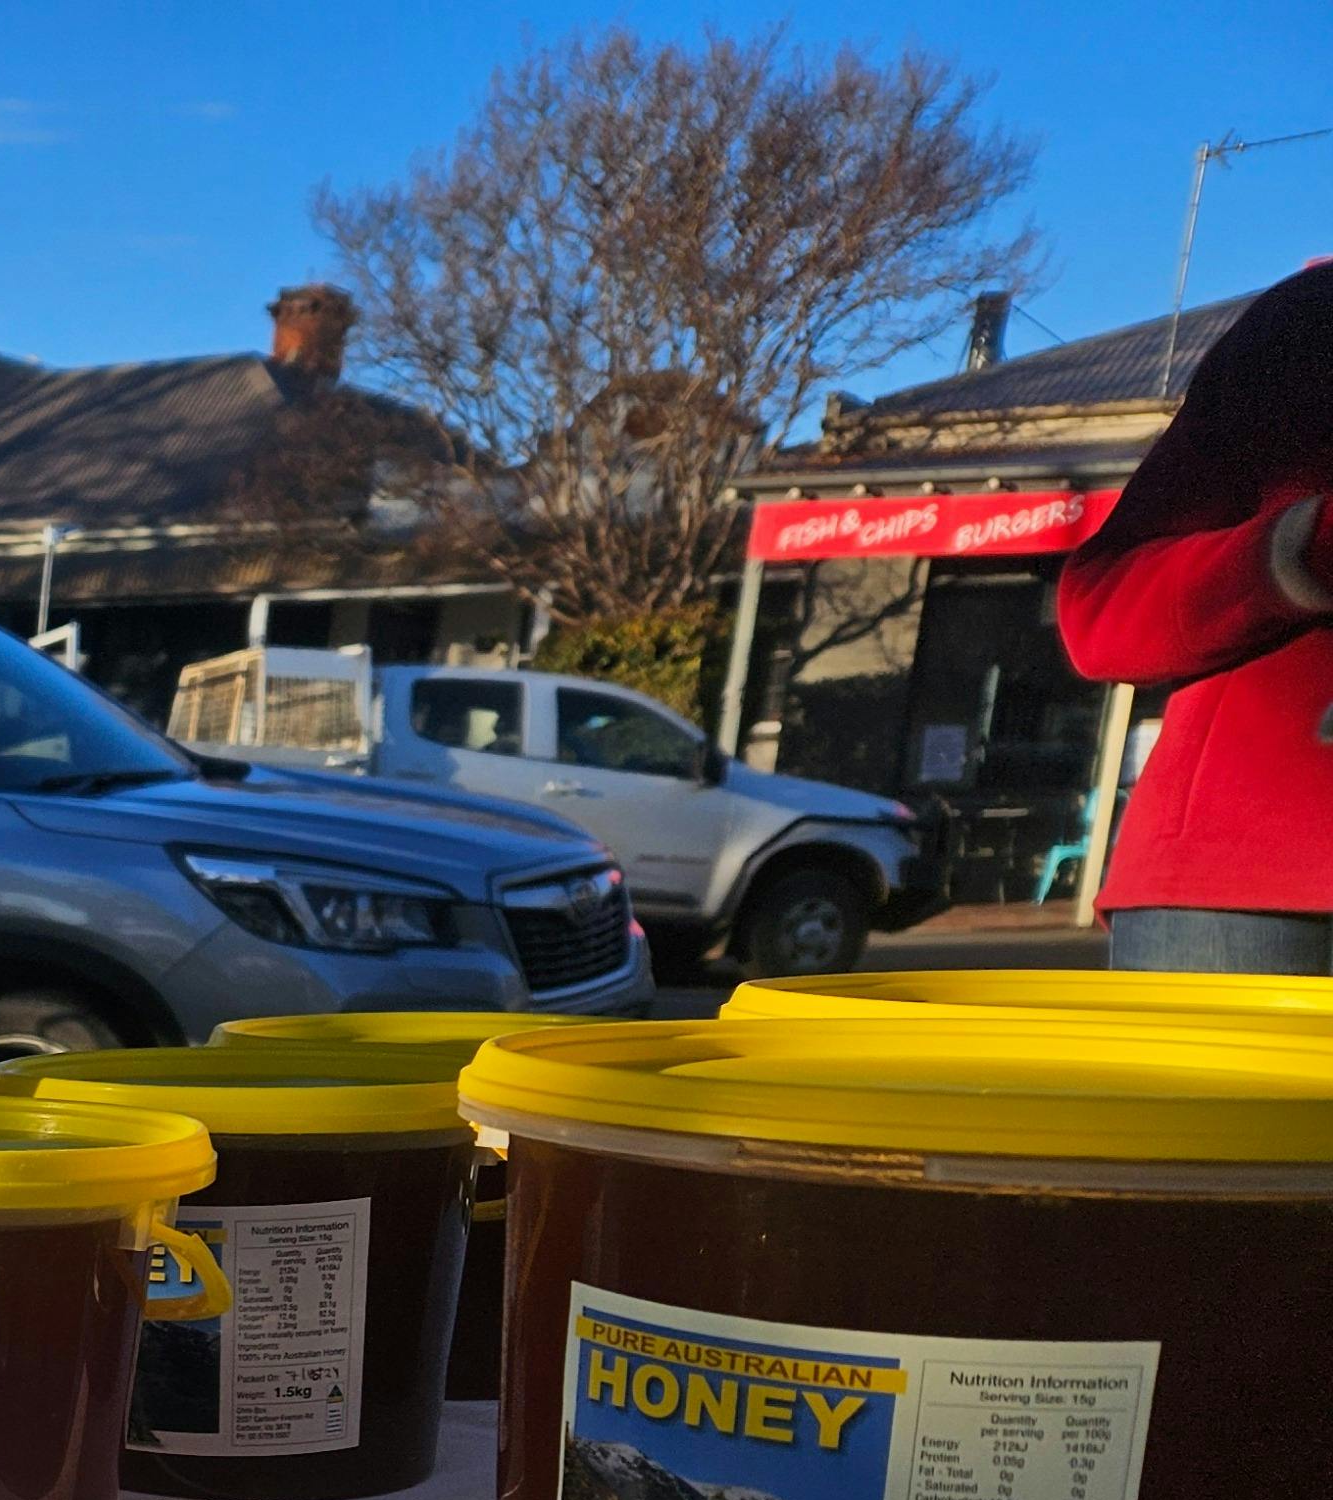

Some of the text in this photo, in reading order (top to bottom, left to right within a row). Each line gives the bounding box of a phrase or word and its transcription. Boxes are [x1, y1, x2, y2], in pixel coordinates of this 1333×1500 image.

[776, 494, 1085, 551] FISH & CHIPS BURGERS
[251, 1221, 349, 1236] Nutrition Information
[593, 1322, 873, 1388] PURE AUSTRALIAN
[274, 1386, 312, 1399] 1.5kg
[587, 1349, 867, 1450] HONEY
[950, 1371, 1128, 1391] Nutrition Information
